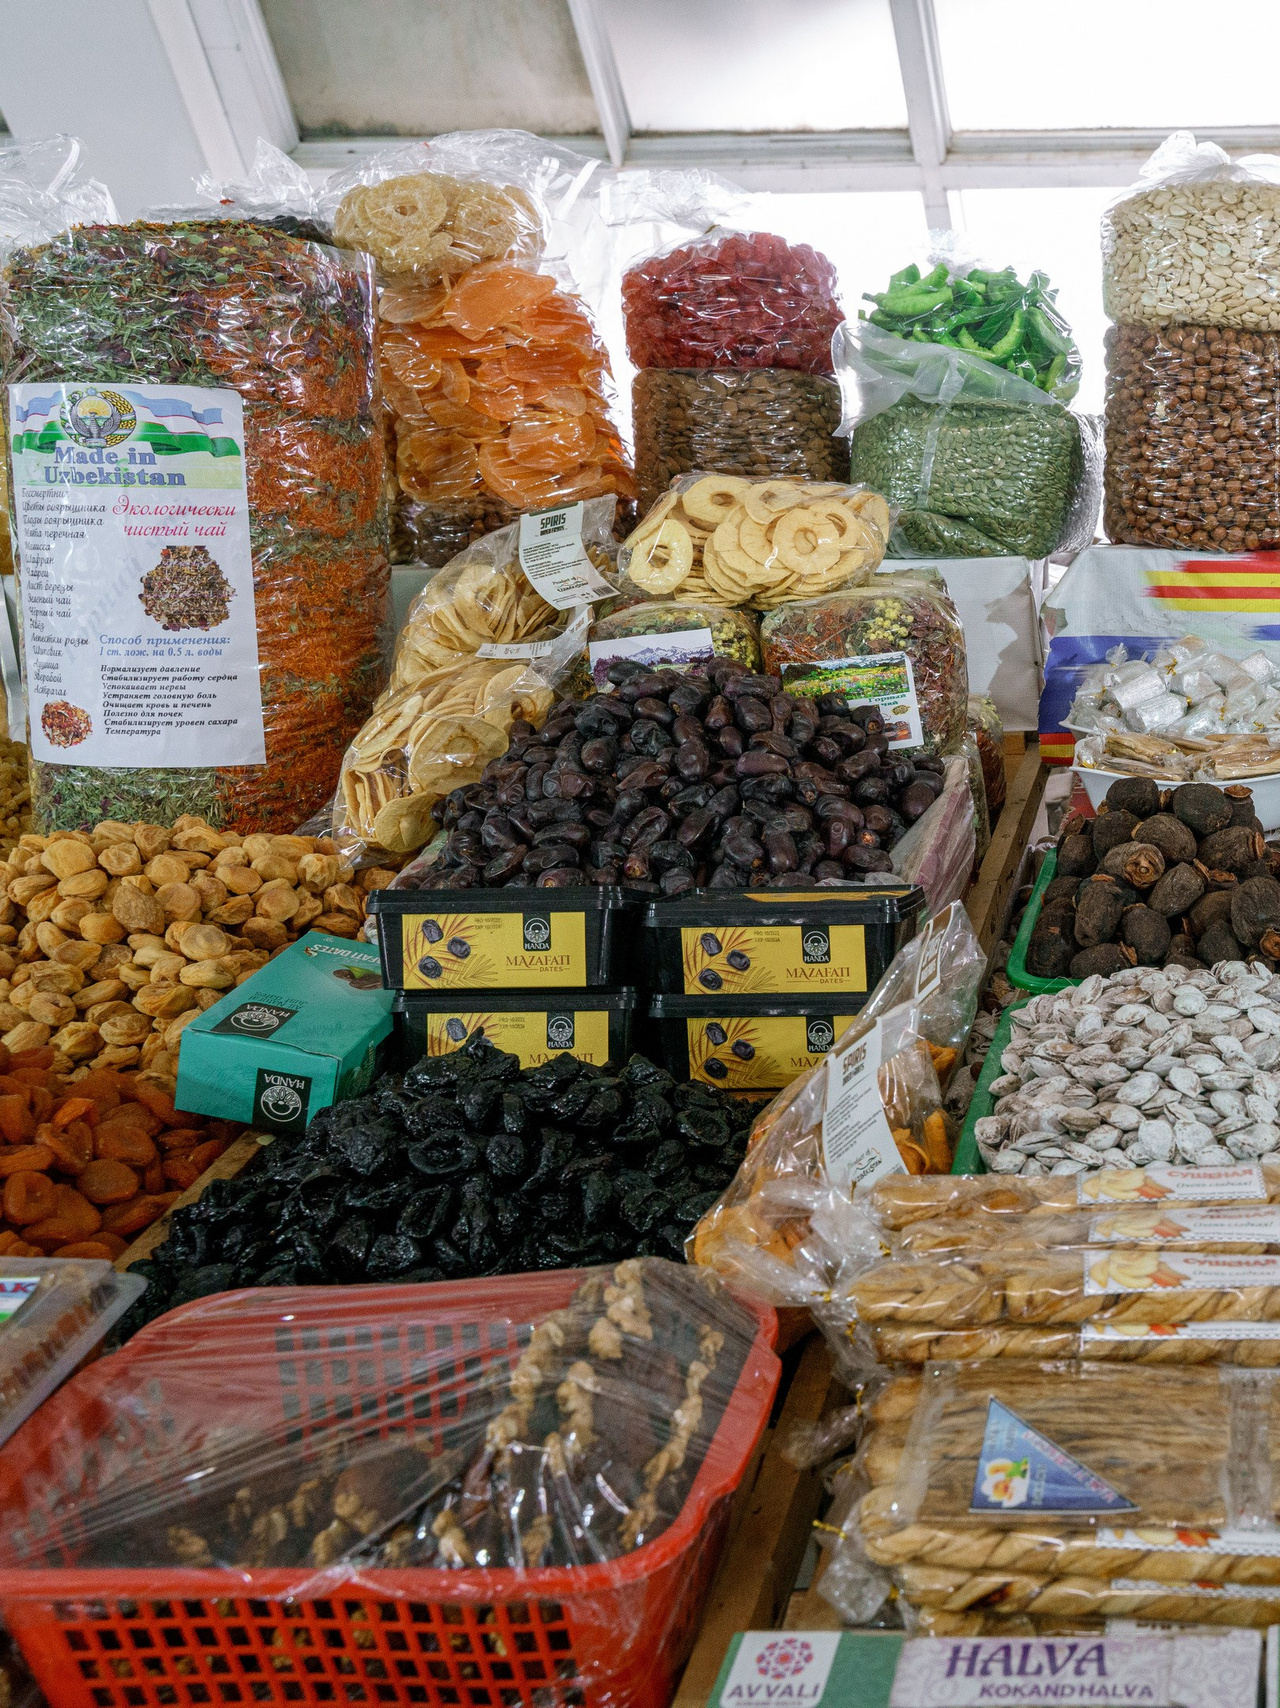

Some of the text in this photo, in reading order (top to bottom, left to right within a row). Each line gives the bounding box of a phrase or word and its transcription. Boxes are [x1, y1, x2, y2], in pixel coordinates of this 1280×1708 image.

[54, 447, 157, 465] Made in
[44, 466, 186, 486] Uzbekistan
[112, 495, 236, 516] Экологически
[540, 513, 566, 530] SPIRIS
[44, 529, 86, 540] перечная
[123, 522, 227, 536] чистый чай
[55, 595, 72, 605] чай
[55, 609, 72, 619] чай
[65, 637, 91, 648] розы
[99, 634, 230, 647] Способ применения:
[106, 648, 121, 656] ст.
[124, 648, 149, 657] лож.
[152, 649, 165, 657] на
[167, 647, 182, 657] 0.5
[184, 649, 194, 657] л.
[197, 648, 223, 657] воды
[100, 665, 201, 674] Нормализует давление
[101, 673, 238, 683] Стабилизирует работу сердца
[102, 682, 186, 692] Успокаивает нервы
[102, 691, 217, 701] Устраняет головную боль
[102, 700, 144, 709] Очищает
[146, 701, 170, 709] кровь
[181, 701, 212, 709] печень
[103, 709, 138, 718] Полезно
[141, 710, 155, 718] для
[104, 718, 238, 728] Стабилизирует уровен сахара
[105, 727, 161, 736] Температура
[311, 944, 352, 957] DATES
[524, 942, 550, 950] HANDA
[506, 954, 570, 968] MAZAFATI
[786, 966, 850, 980] MAZAFATI
[246, 1004, 290, 1018] HANDA
[264, 1073, 305, 1090] HANDA
[945, 1641, 1110, 1678] HALVA
[727, 1682, 820, 1699] AVVALI
